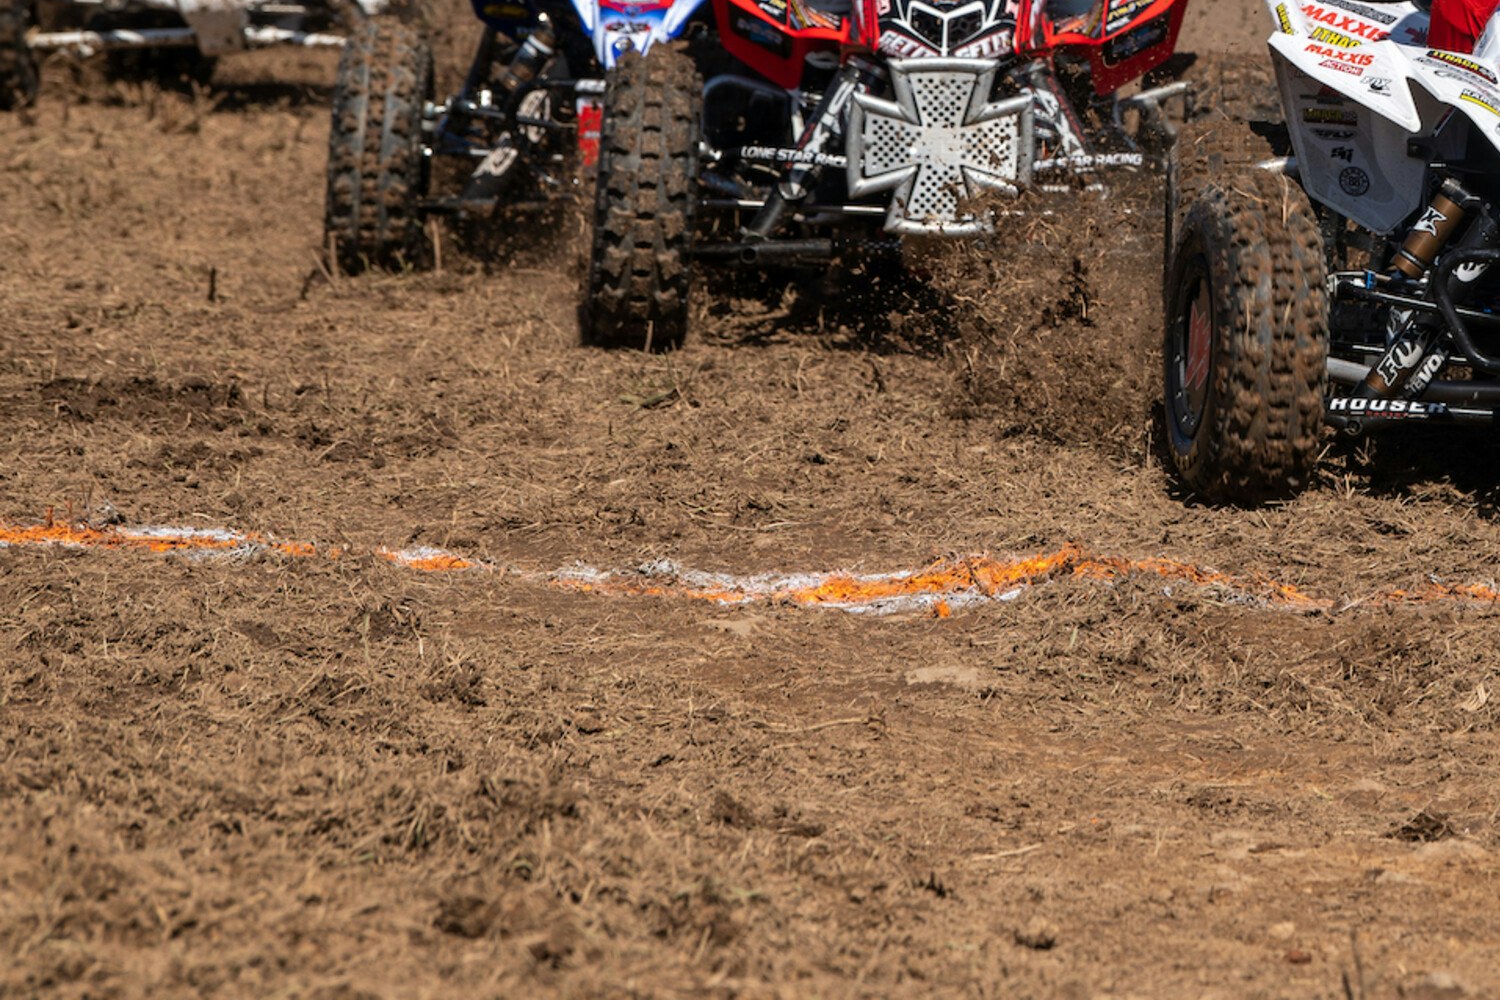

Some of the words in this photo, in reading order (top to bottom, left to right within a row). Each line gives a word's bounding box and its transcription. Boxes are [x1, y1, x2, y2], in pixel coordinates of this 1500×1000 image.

[1301, 4, 1392, 42] MAXXIS
[1312, 27, 1361, 49] ITHAC
[1304, 44, 1374, 66] MAXXIS
[741, 146, 776, 160] LONE
[777, 149, 813, 164] STAR
[1095, 153, 1143, 166] RACING
[1329, 398, 1447, 412] HOUSER
